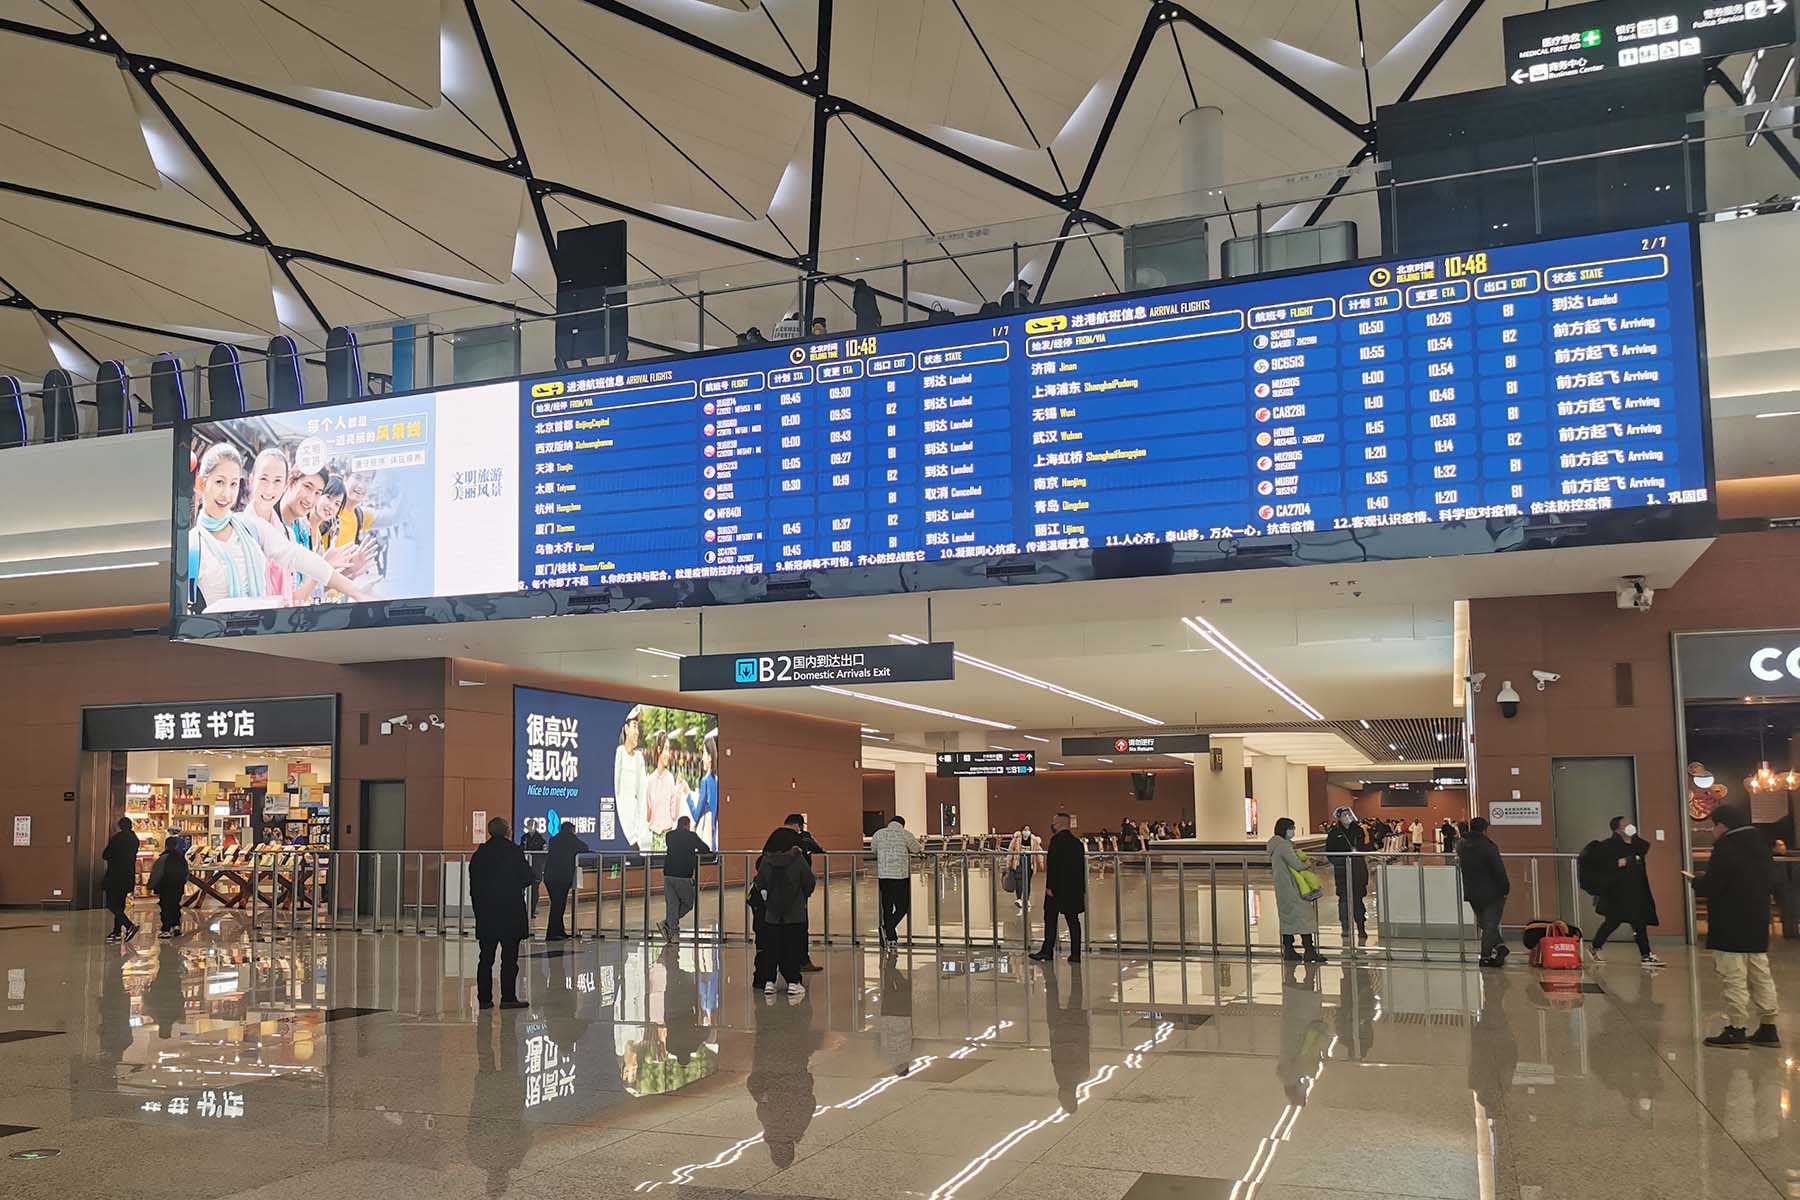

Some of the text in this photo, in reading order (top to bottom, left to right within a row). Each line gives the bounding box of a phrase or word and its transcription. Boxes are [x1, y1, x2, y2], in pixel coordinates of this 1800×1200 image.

[1519, 42, 1581, 58] MEDICAL FIRST AID
[1549, 64, 1604, 79] Business Center
[1642, 237, 1666, 250] 2/7
[1396, 261, 1434, 274] 北京时间
[1445, 253, 1487, 278] 10:48
[1552, 267, 1603, 284] 状态 STATE
[1484, 277, 1527, 293] 出口 EXIT
[1415, 287, 1455, 302] 变更 ETA
[1348, 296, 1388, 310] 计划 STA
[1552, 293, 1618, 311] 到达 Landed
[1072, 300, 1210, 328] 进港航班信息 ARRIVAL FLIGHTS
[1255, 306, 1313, 323] 航班号 FLIGHT
[1503, 304, 1514, 317] B1
[993, 326, 1008, 336] 1/7
[1359, 320, 1384, 335] 10:50
[1553, 318, 1655, 337] 前方起飞 Arriving
[1503, 329, 1517, 343] B2
[810, 343, 838, 353] 北京时间
[846, 337, 877, 357] 10:48
[1031, 338, 1073, 352] 始发/经停
[1428, 337, 1453, 351] 10:54
[924, 352, 961, 365] 状态 STATE
[1360, 345, 1384, 360] 10:55
[1555, 344, 1657, 363] 前方起飞 Arriving
[874, 359, 905, 371] 出口 EXIT
[1032, 362, 1056, 375] 济南
[1505, 355, 1516, 368] B1
[823, 366, 853, 378] 变更 ETA
[1362, 370, 1384, 384] 11:00
[1429, 363, 1454, 377] 10:54
[567, 371, 672, 393] 进港航班信息 ARRIVAL FLIGHTS
[731, 379, 748, 388] FLIGHT
[774, 372, 803, 384] 计划 STA
[924, 374, 972, 388] 到达 Landed
[1556, 370, 1658, 389] 前方起飞 Arriving
[1032, 382, 1081, 398] 上海浦东
[1506, 381, 1518, 394] B1
[1429, 388, 1455, 402] 10:48
[924, 396, 972, 410] 到达 Landed
[1365, 396, 1383, 409] 11:10
[1558, 397, 1660, 415] 前方起飞 Arriving
[782, 414, 800, 426] 10:00
[1033, 407, 1057, 421] 无锡
[1430, 413, 1456, 427] 10:58
[1508, 407, 1519, 420] B1
[535, 420, 574, 434] 北京首都
[924, 419, 973, 432] 到达 Landed
[1366, 421, 1384, 434] 11:15
[1559, 423, 1662, 442] 前方起飞 Arriving
[782, 436, 800, 448] 10:00
[1033, 430, 1057, 444] 武汉
[1508, 432, 1522, 446] B2
[536, 440, 574, 454] 西双版纳
[925, 442, 973, 455] 到达 Landed
[1365, 446, 1386, 459] 11:20
[1435, 440, 1453, 453] 11:14
[1034, 451, 1083, 467] 上海虹桥
[1510, 459, 1522, 472] B1
[1560, 450, 1663, 468] 前方起飞 Arriving
[536, 462, 554, 474] 天津
[925, 466, 948, 477] 到达
[1434, 465, 1456, 478] 11:32
[451, 467, 503, 487] 文明旅游
[1034, 476, 1058, 490] 南京
[1366, 471, 1387, 484] 11:35
[451, 482, 503, 501] 美丽风景
[536, 482, 554, 494] 太原
[1561, 476, 1665, 495] 前方起飞 Arriving
[925, 487, 948, 500] 取消
[1435, 490, 1457, 504] 11:20
[535, 503, 555, 515] 杭州
[1035, 500, 1059, 513] 青岛
[1367, 496, 1388, 509] 11:40
[926, 509, 949, 522] 到达
[1276, 503, 1311, 517] CA2704
[535, 523, 554, 535] 厦门
[783, 523, 801, 534] 10:45
[1035, 523, 1060, 536] 丽江
[926, 534, 949, 545] 到达
[536, 542, 573, 555] 乌鲁木齐
[783, 545, 801, 556] 10:45
[535, 562, 577, 576] 厦门/桂林
[793, 653, 864, 669] 国内到达出口
[759, 656, 792, 682] B2
[793, 667, 891, 681] Domestic Arrivals Exit
[154, 710, 255, 740] 蔚蓝书店
[526, 713, 578, 749] 很高兴
[526, 748, 578, 782] 遇见你
[528, 785, 578, 799] Nice to meet you
